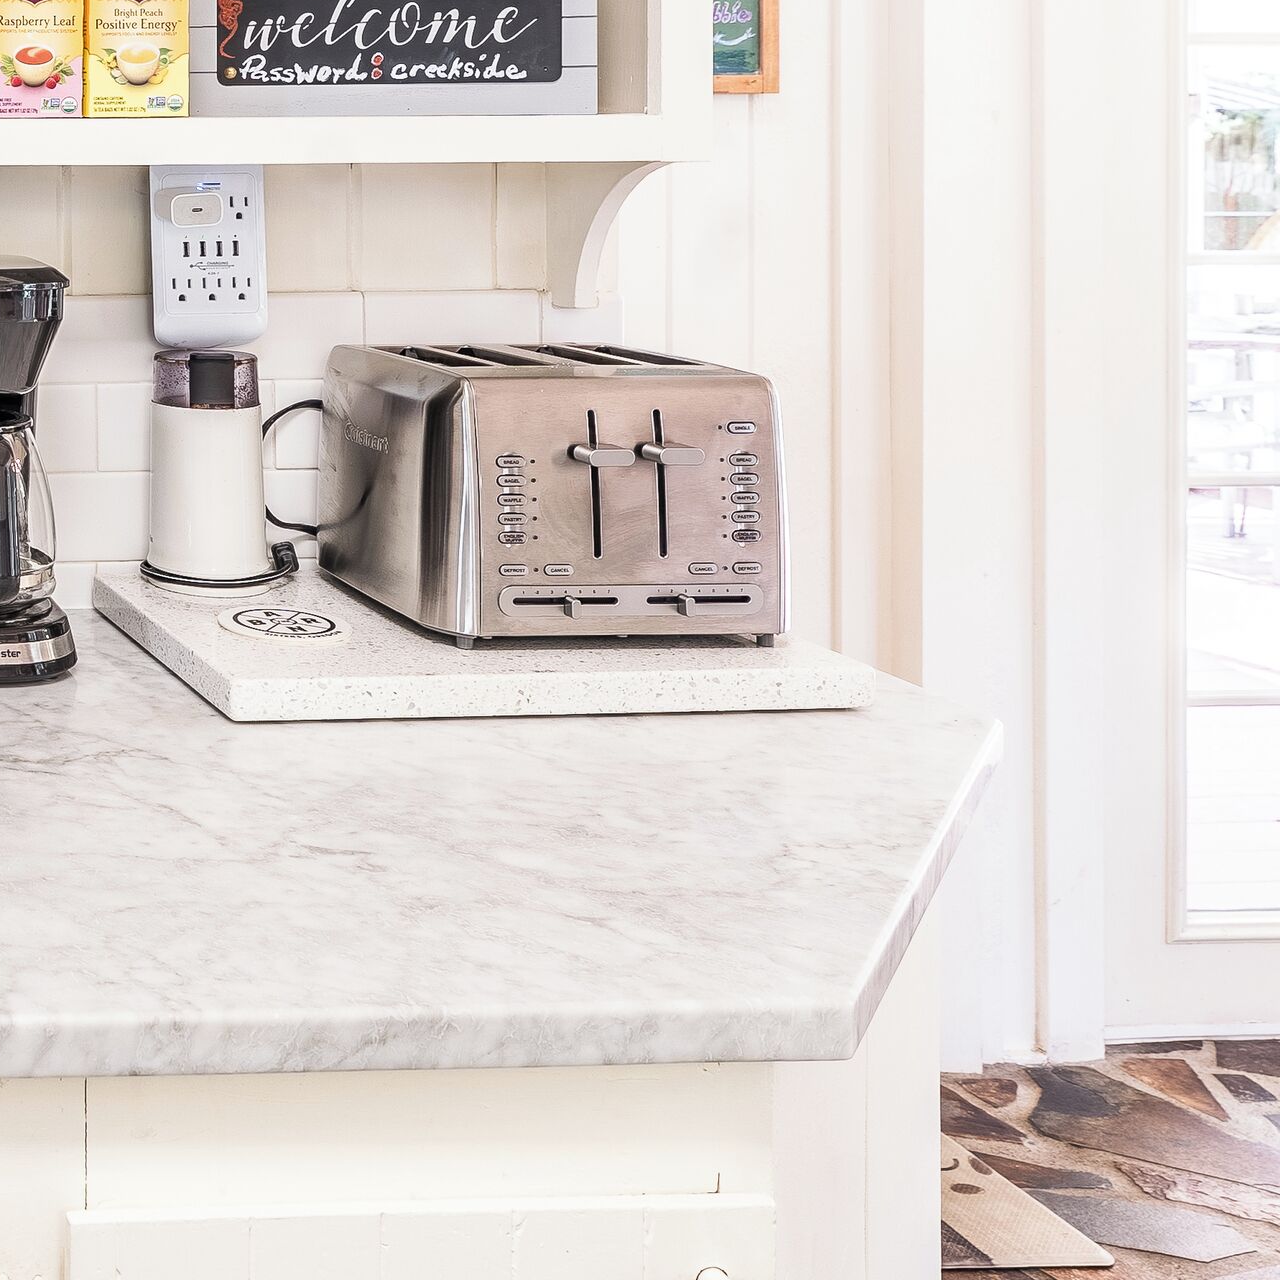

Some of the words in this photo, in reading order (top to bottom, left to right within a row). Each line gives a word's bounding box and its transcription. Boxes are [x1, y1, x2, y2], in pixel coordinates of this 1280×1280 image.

[114, 8, 138, 18] Bright
[140, 8, 163, 16] Peach
[53, 15, 76, 26] Leaf
[95, 18, 138, 30] Positive
[390, 54, 527, 81] creekside
[343, 421, 390, 455] Cuisinart
